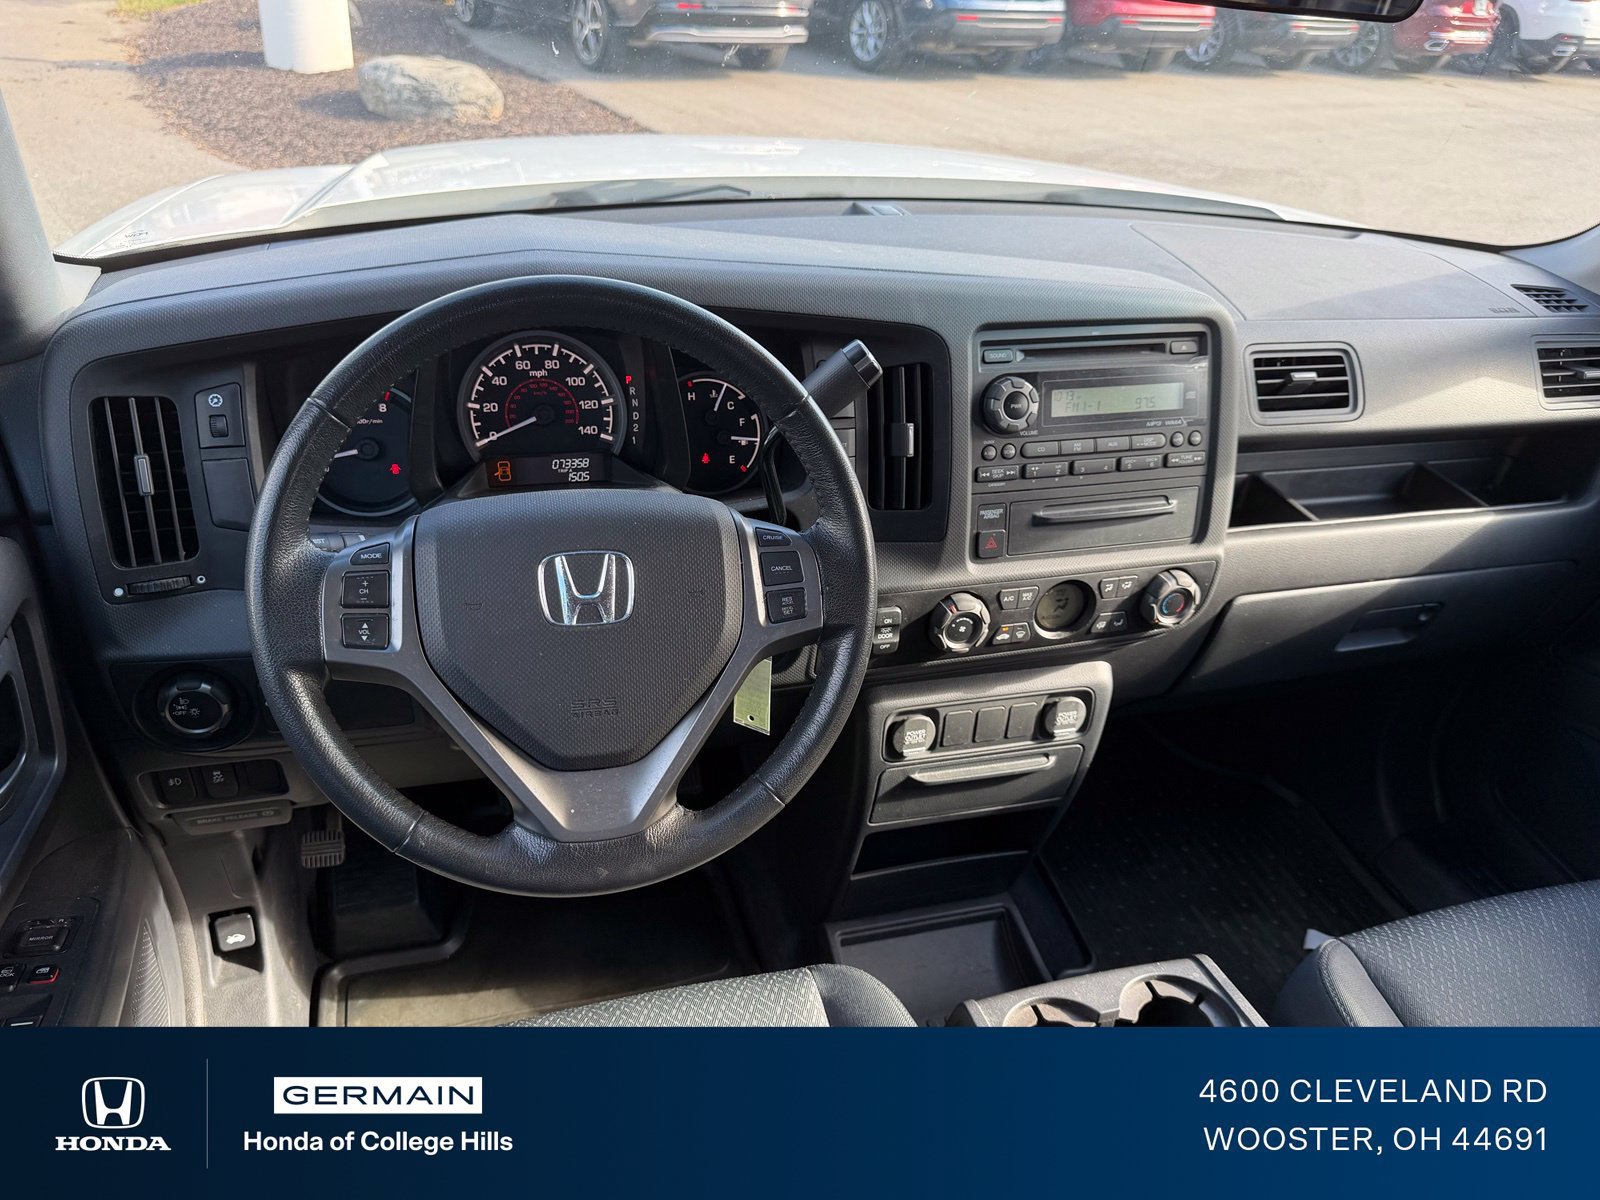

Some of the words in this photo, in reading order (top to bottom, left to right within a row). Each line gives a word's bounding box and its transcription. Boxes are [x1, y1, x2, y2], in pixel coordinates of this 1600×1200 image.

[515, 360, 531, 370] 60
[544, 360, 560, 370] 80
[529, 369, 548, 379] mph
[491, 376, 508, 386] 40
[565, 377, 586, 387] 100
[625, 375, 632, 384] P
[629, 386, 636, 396] R
[687, 392, 696, 401] H
[578, 400, 599, 410] 120
[631, 398, 639, 407] N
[726, 401, 735, 410] C
[379, 403, 387, 413] 8
[482, 403, 499, 413] 20
[632, 412, 640, 420] D
[632, 423, 640, 432] 2
[739, 418, 746, 427] F
[577, 426, 598, 436] 140
[631, 436, 637, 445] 1
[552, 458, 590, 470] 073358
[729, 455, 737, 464] E
[877, 632, 893, 640] DOOR
